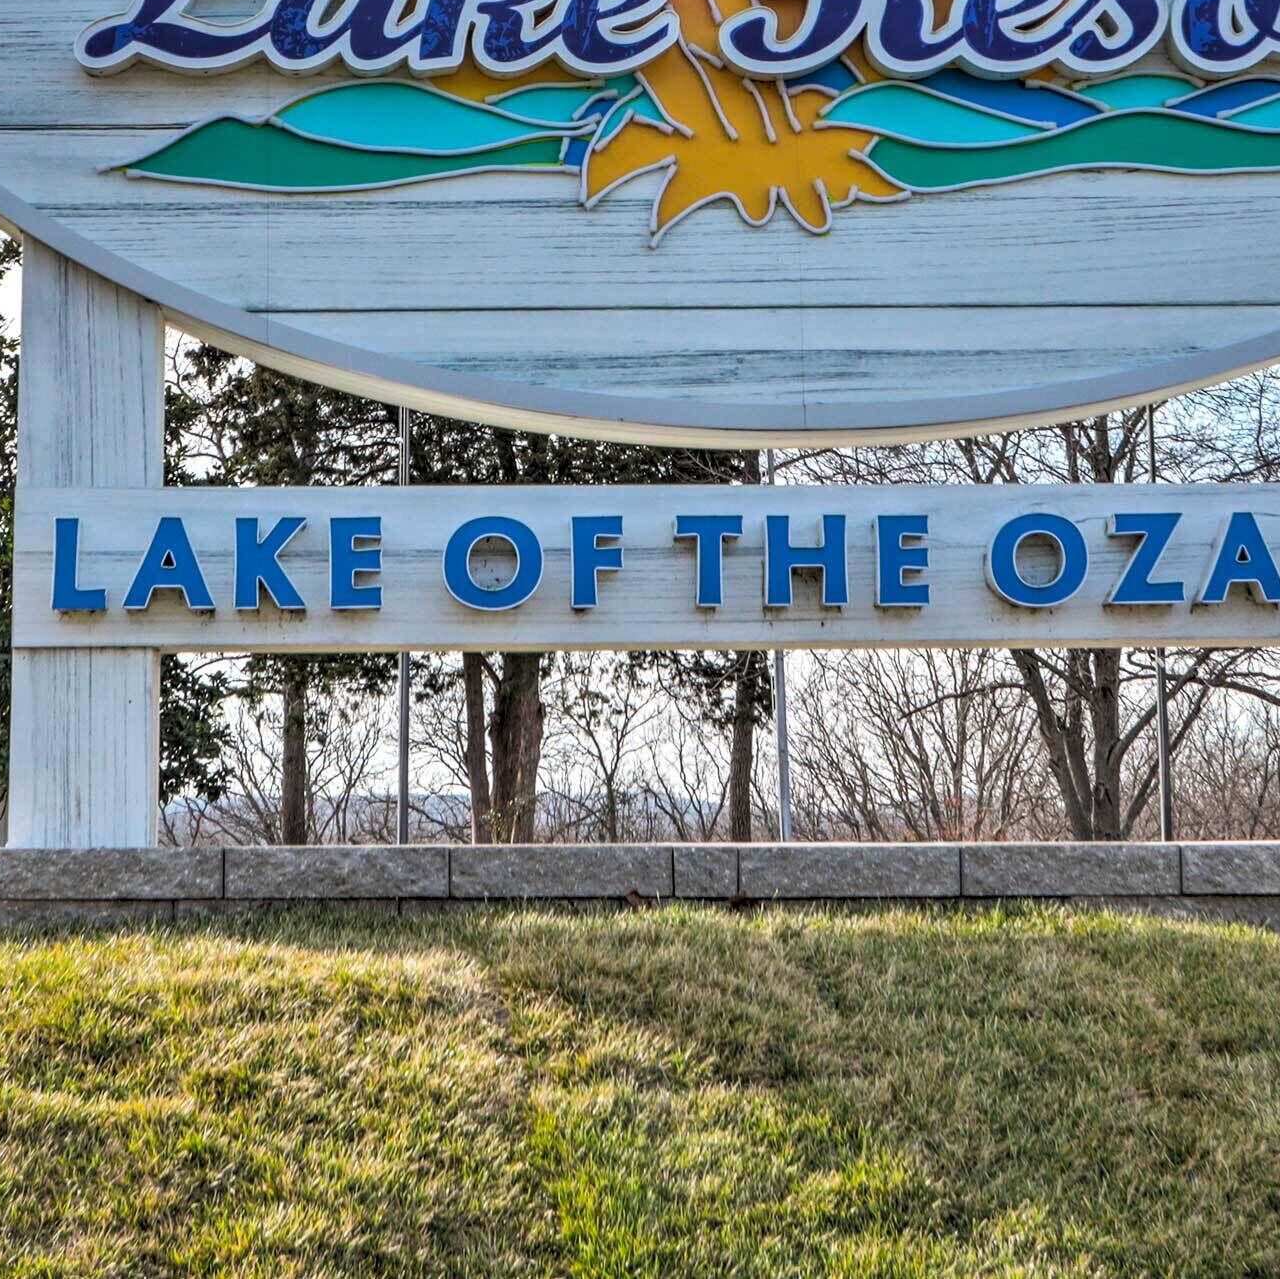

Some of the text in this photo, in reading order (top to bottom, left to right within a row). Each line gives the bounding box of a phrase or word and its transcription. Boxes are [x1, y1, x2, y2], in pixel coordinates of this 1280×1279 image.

[51, 515, 384, 612] LAKE
[442, 514, 624, 612] OF
[672, 513, 931, 609] THE
